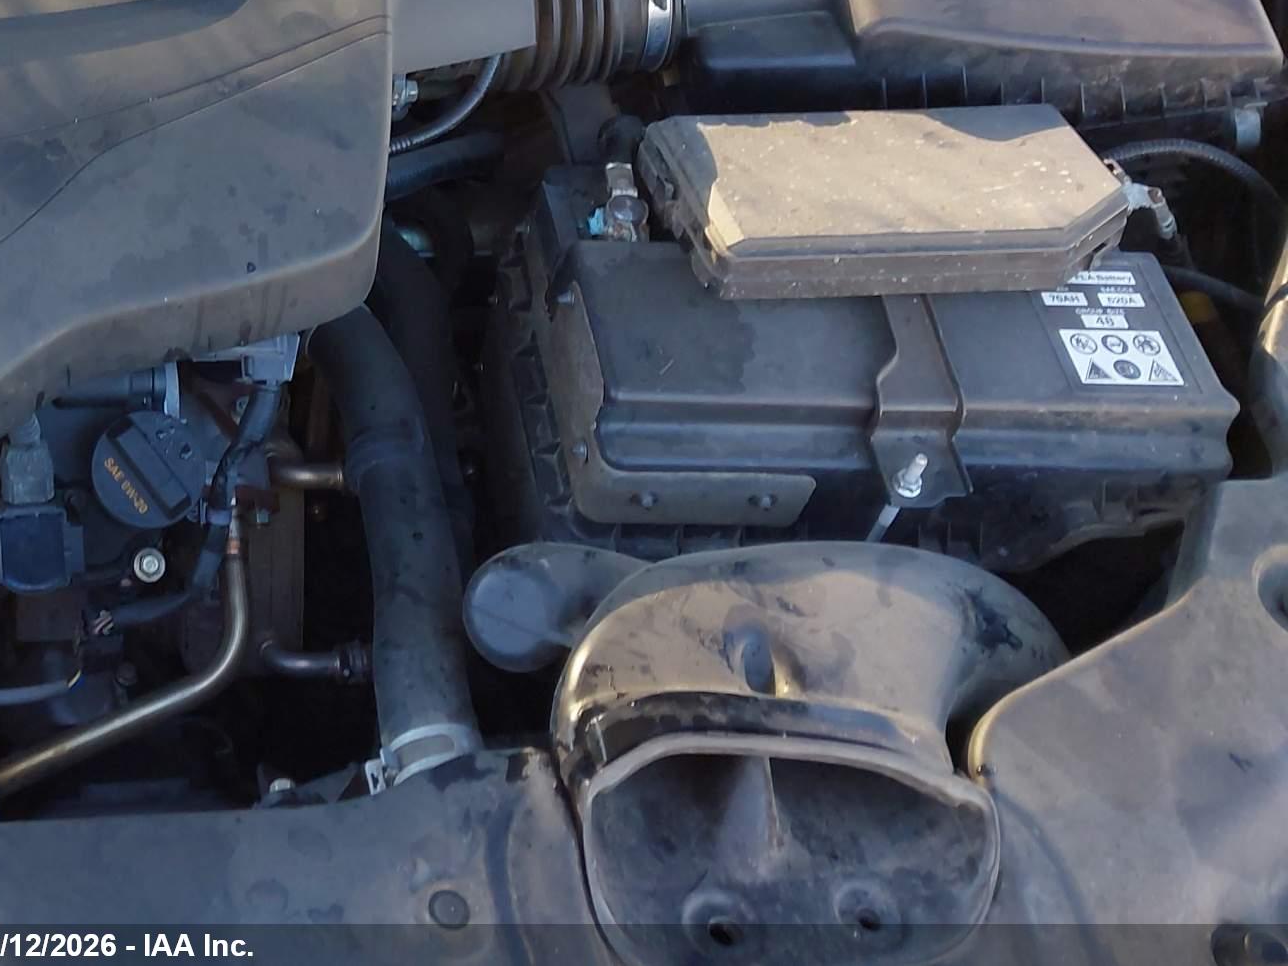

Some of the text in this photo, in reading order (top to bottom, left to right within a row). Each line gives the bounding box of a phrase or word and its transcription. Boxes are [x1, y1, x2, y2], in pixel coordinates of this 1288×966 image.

[1096, 273, 1133, 283] Battery
[104, 457, 149, 514] SAE 0W-20
